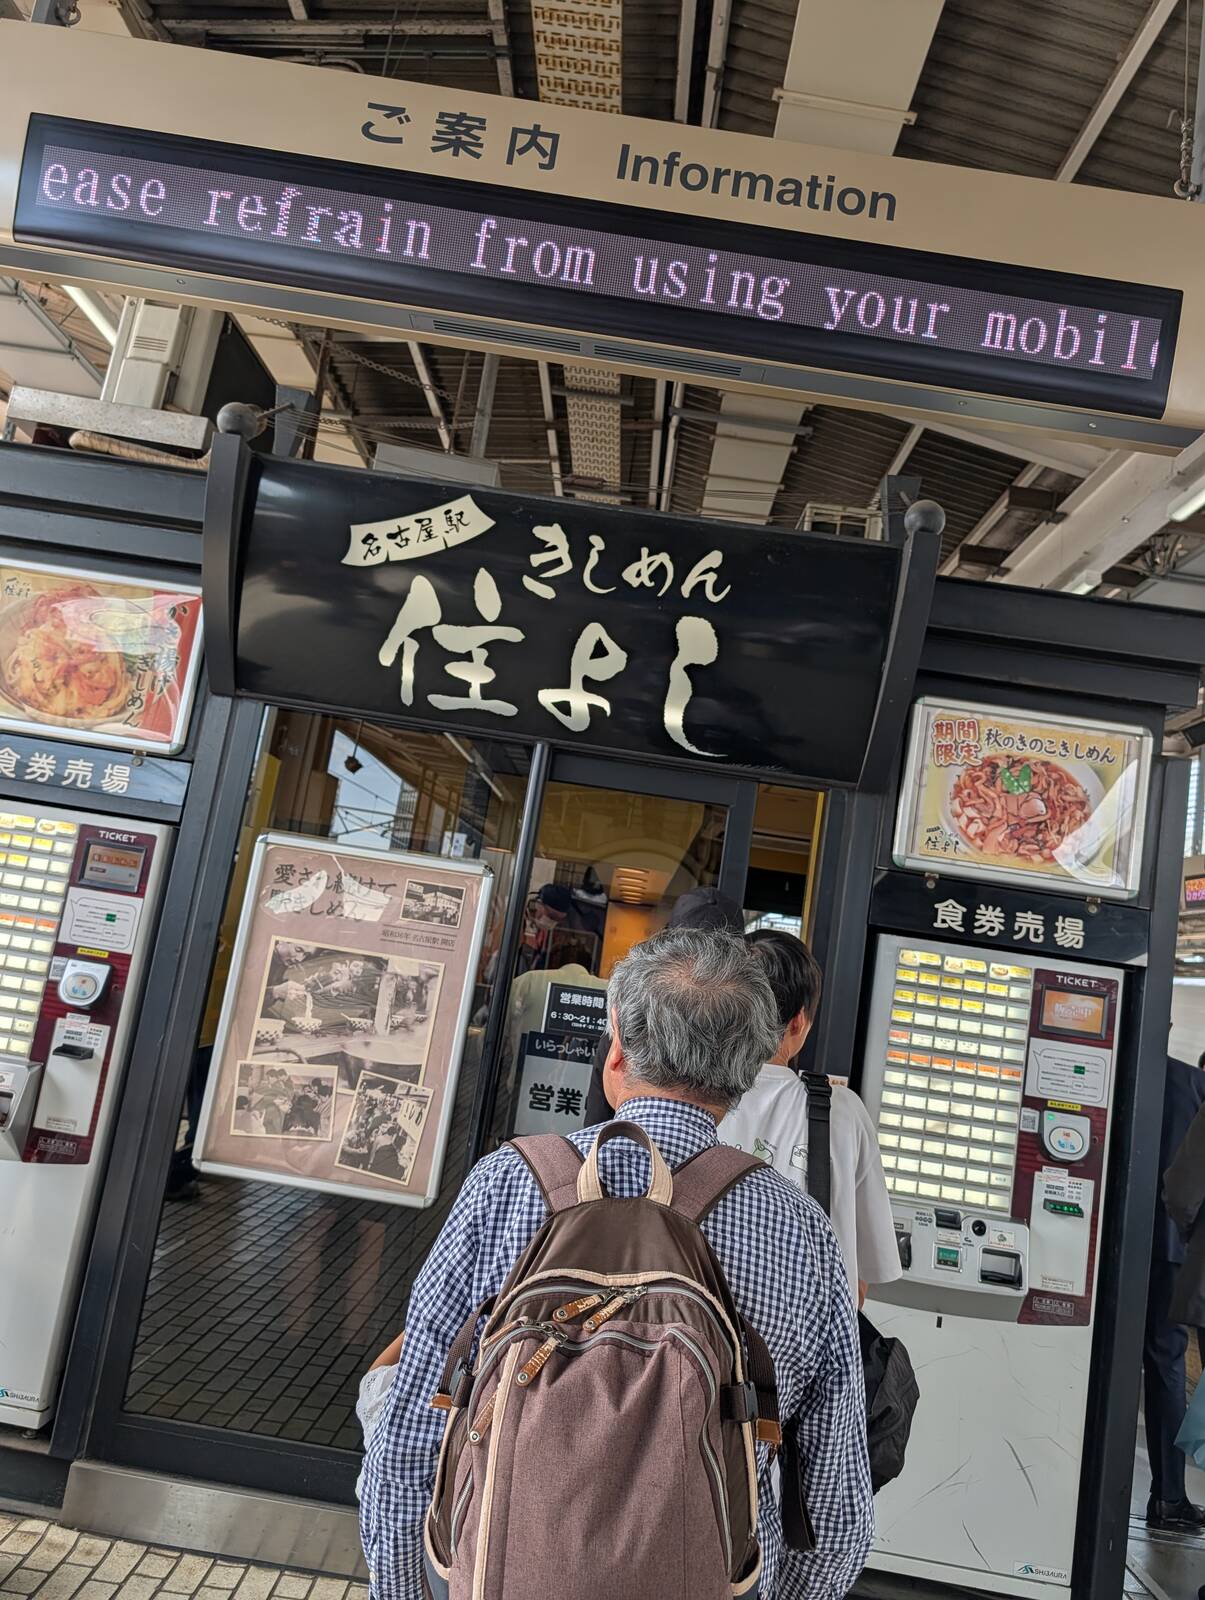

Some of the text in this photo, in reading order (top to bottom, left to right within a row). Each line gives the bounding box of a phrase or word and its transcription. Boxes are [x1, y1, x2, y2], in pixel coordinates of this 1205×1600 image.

[361, 101, 561, 171] ご案内
[615, 143, 897, 222] Information
[42, 162, 167, 216] ease
[203, 186, 431, 260] refrain
[470, 218, 595, 285] from
[631, 252, 790, 321] using
[824, 284, 949, 340] your
[361, 508, 470, 561] 名古屋駅
[522, 522, 732, 604] きしめん
[378, 567, 729, 758] 住よし
[933, 718, 978, 742] 期間
[934, 742, 982, 766] 限定
[984, 727, 1116, 765] 秋のきのこきしめん
[0, 746, 131, 795] 食券売場
[99, 830, 138, 844] TICKET
[933, 898, 1086, 950] 食券売場
[560, 991, 605, 1009] 営業時間
[1056, 974, 1097, 988] TICKET
[529, 1082, 588, 1117] 営業
